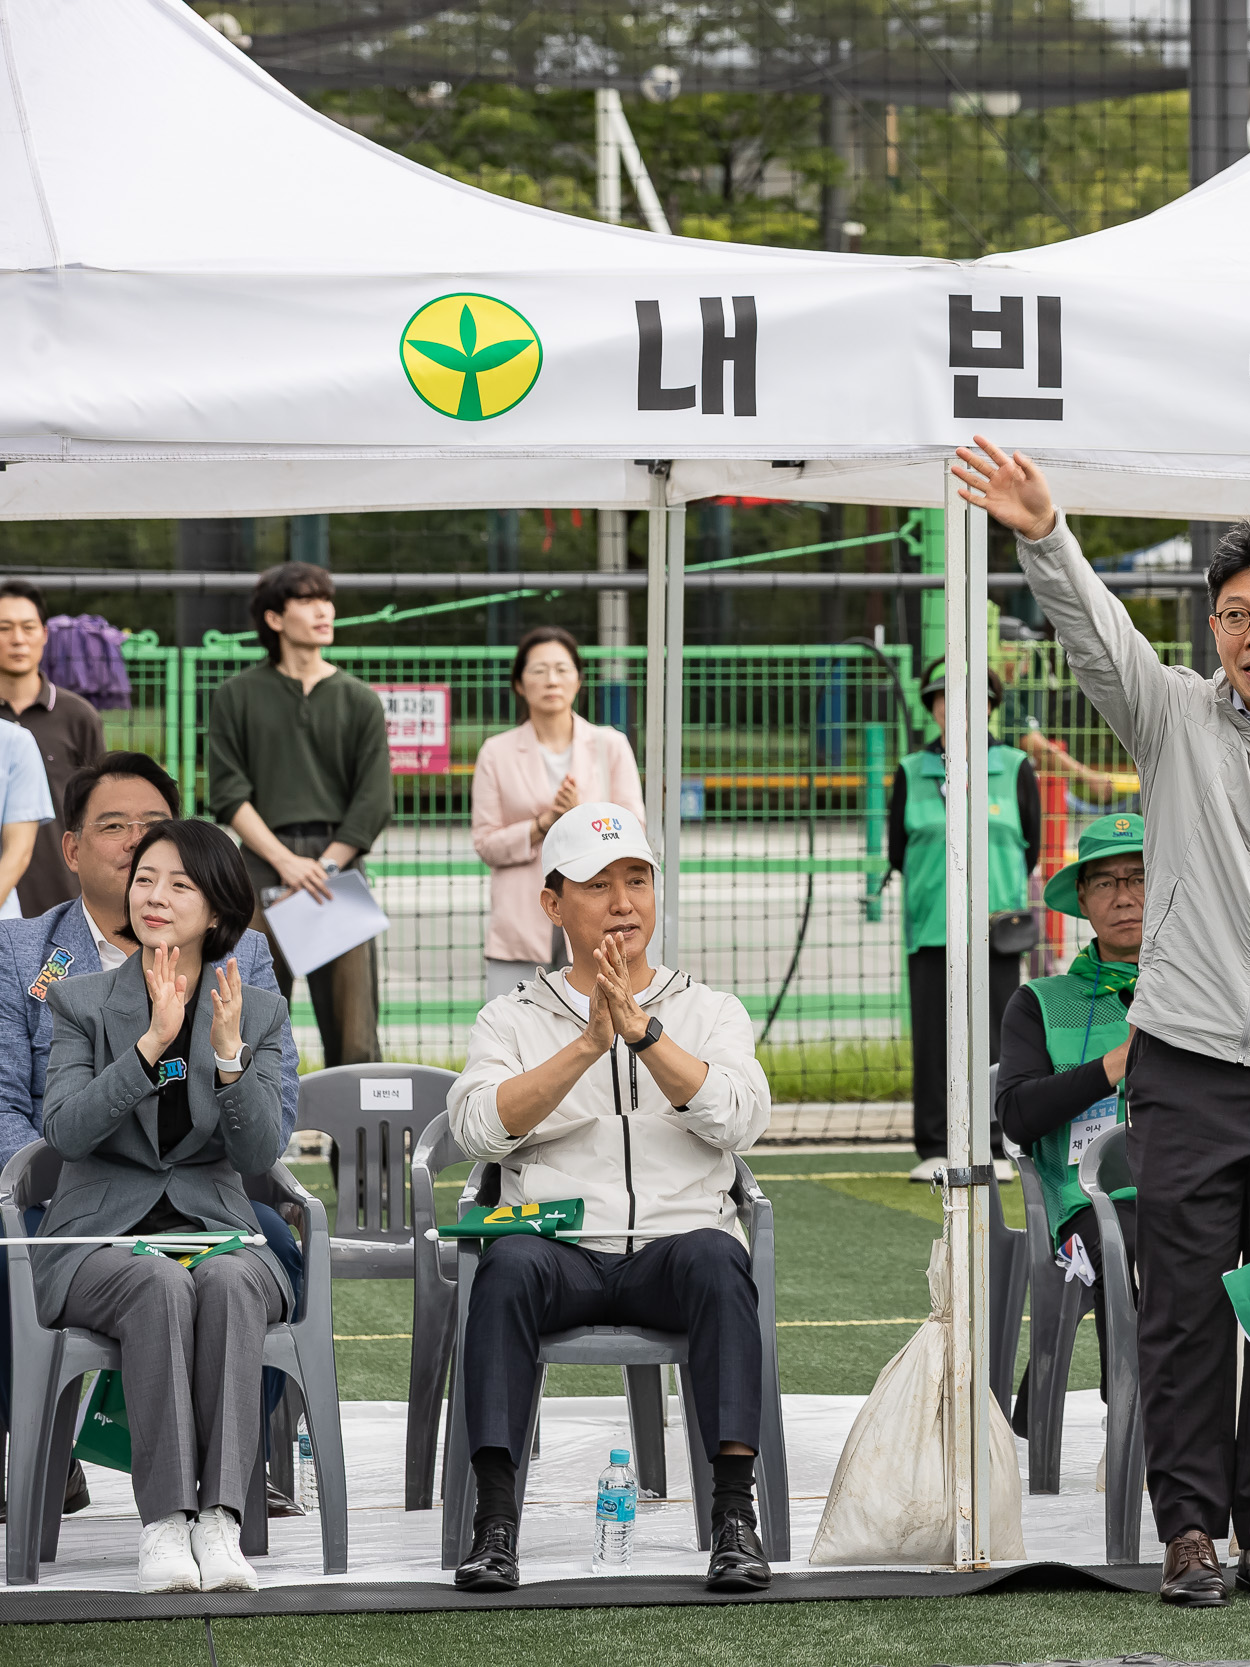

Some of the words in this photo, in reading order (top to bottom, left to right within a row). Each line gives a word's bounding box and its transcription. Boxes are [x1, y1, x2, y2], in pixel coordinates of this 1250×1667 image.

[635, 296, 757, 416] 내
[948, 294, 1064, 421] 빈
[1085, 1123, 1102, 1133] 이사
